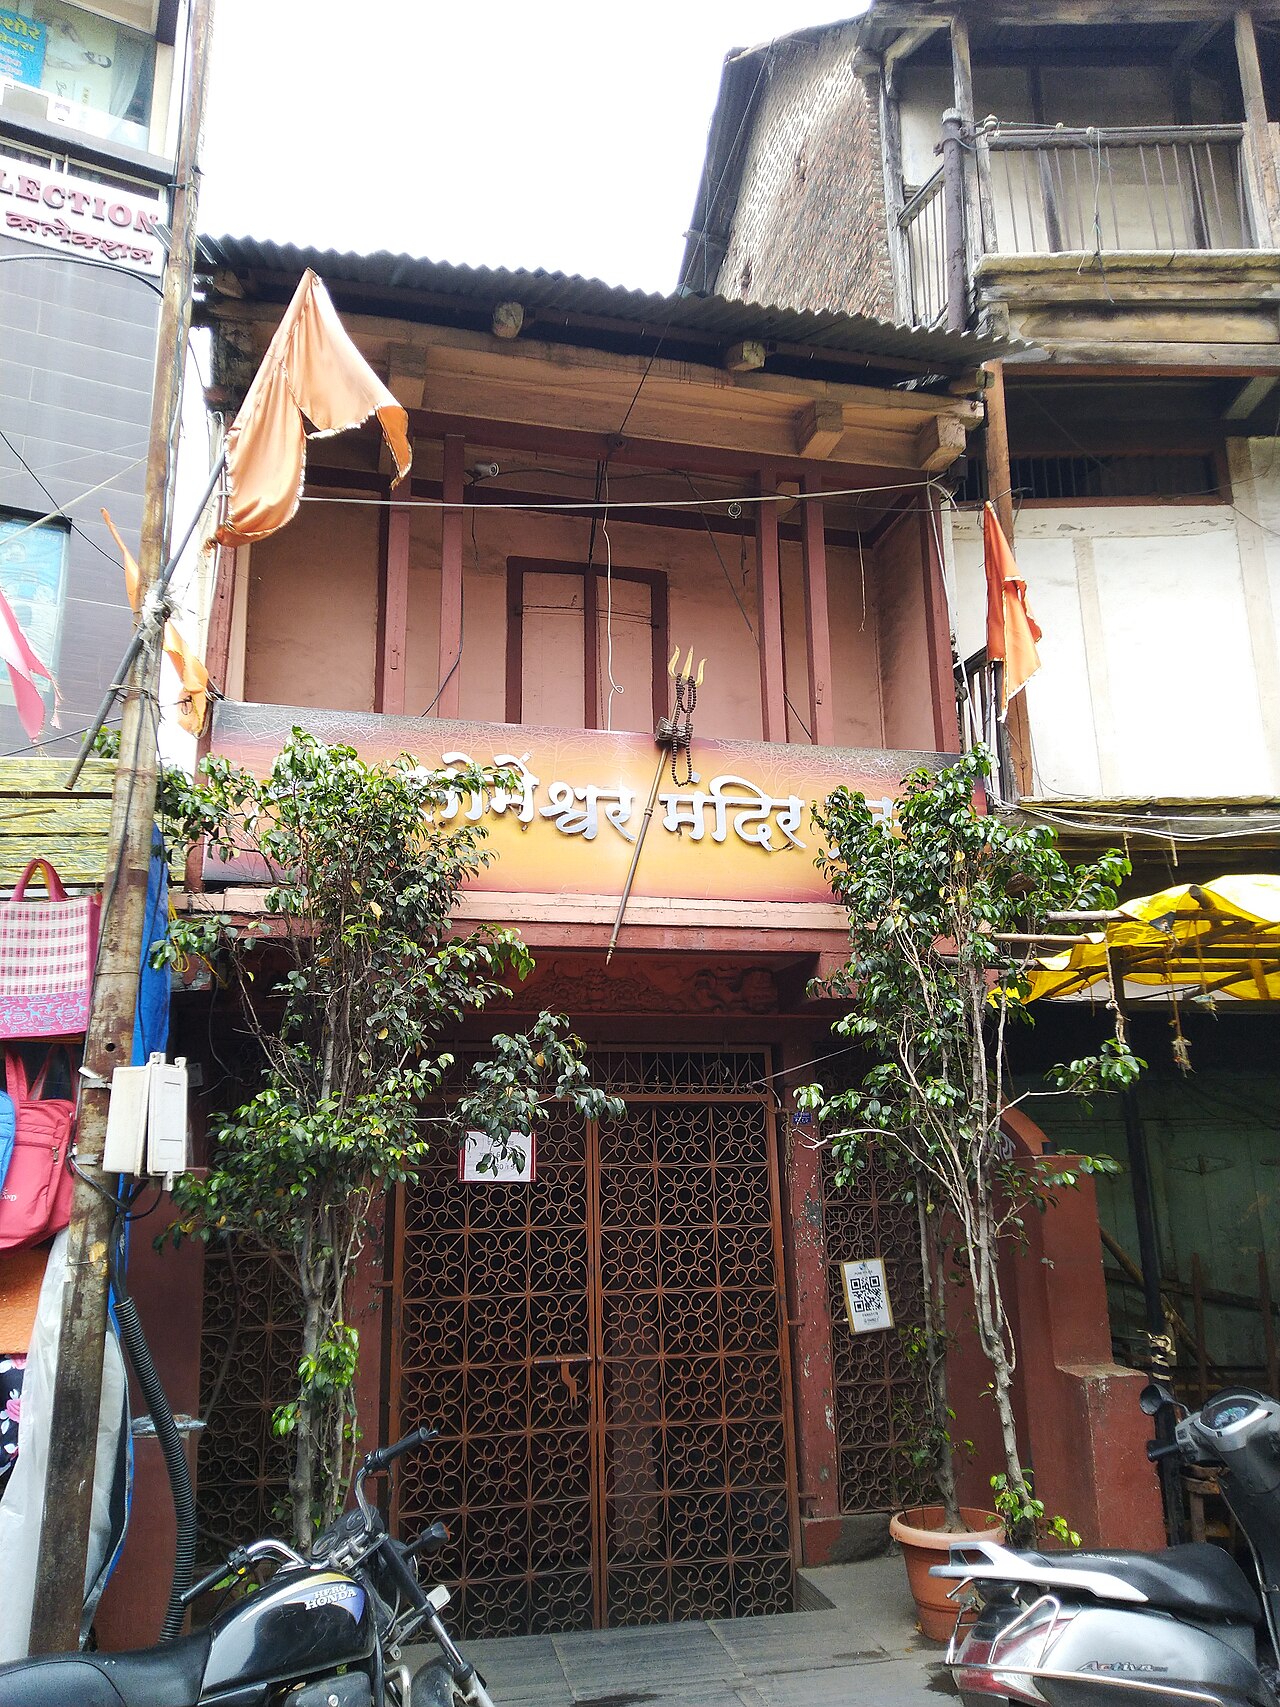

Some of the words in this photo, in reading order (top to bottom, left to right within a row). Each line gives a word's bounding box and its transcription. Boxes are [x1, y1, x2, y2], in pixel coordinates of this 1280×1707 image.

[0, 170, 158, 235] LECTION
[658, 772, 807, 852] मंदिर
[304, 1589, 357, 1611] HONDA
[313, 1584, 347, 1599] HERO
[1075, 1660, 1154, 1672] Activa
